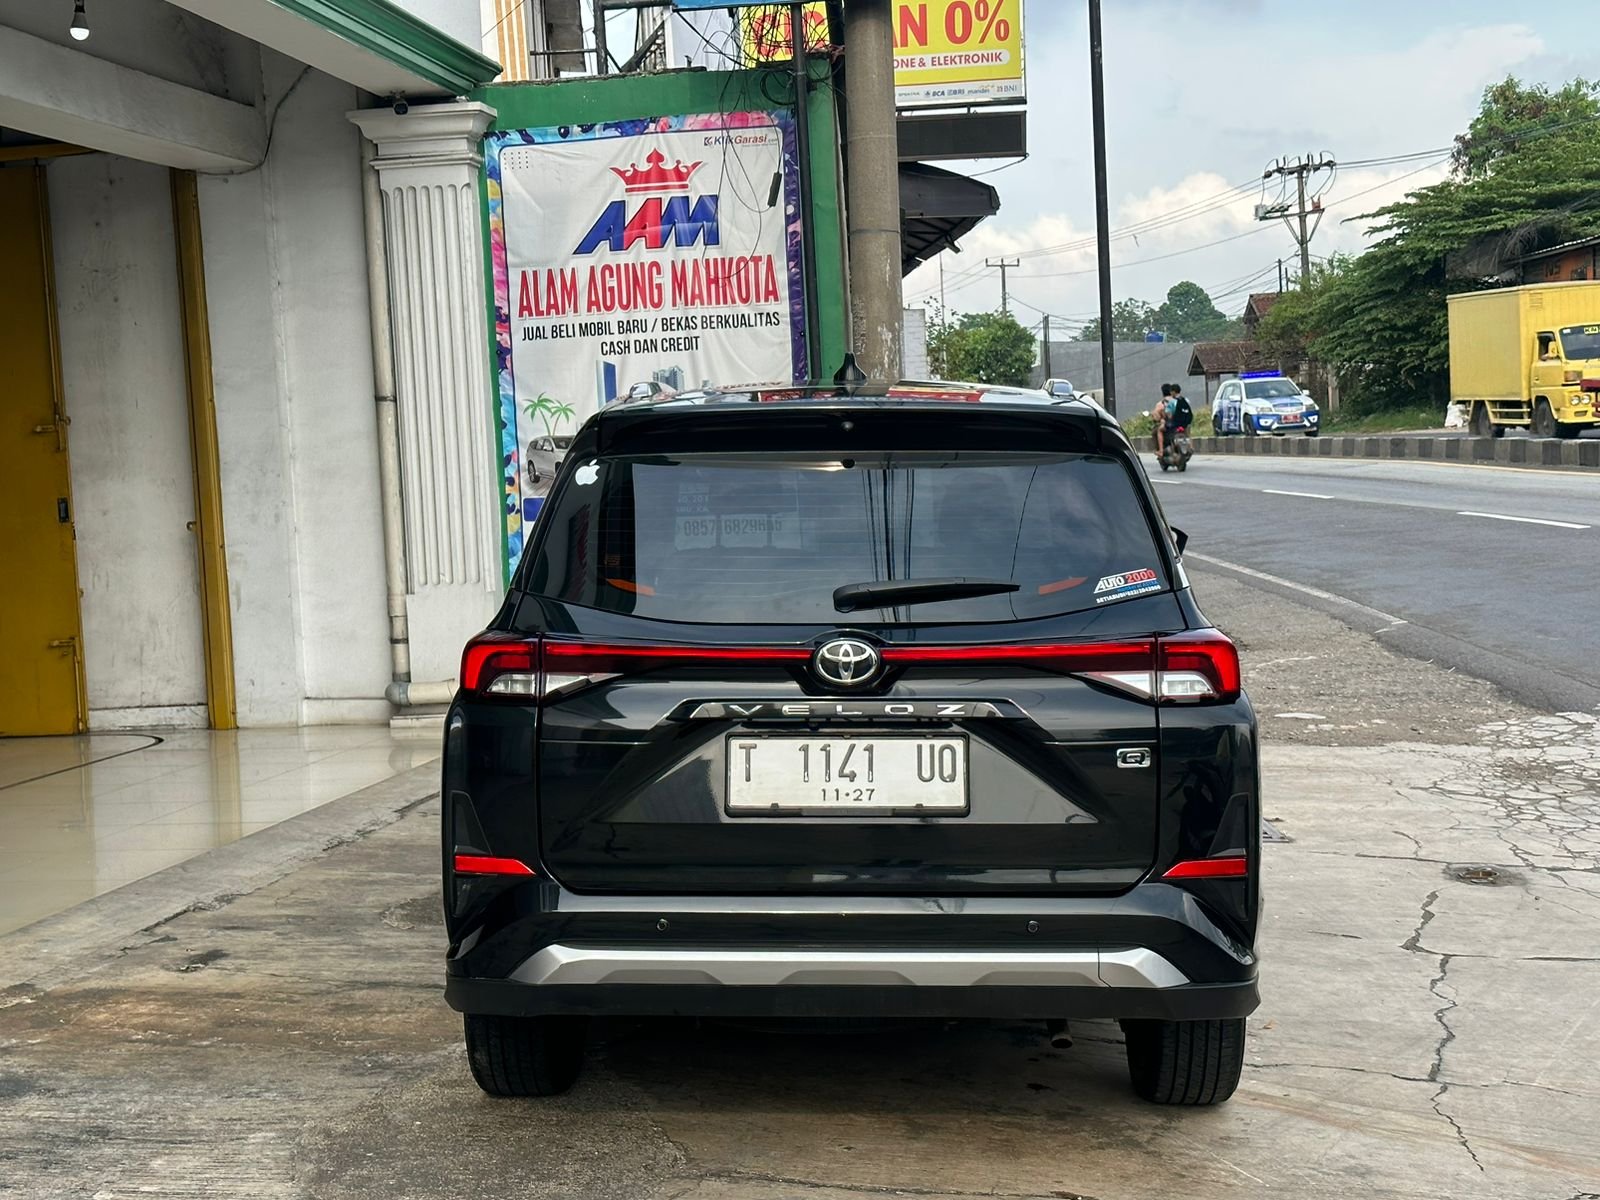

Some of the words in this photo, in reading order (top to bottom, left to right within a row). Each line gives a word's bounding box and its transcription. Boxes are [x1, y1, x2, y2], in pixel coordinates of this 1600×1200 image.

[944, 0, 1010, 45] 0%
[918, 56, 926, 68] &
[931, 51, 1003, 67] ELEKTRONIK
[572, 194, 720, 255] AAM
[518, 267, 579, 318] ALAM
[586, 260, 663, 313] AGUNG
[671, 254, 780, 308] MAHKOTA
[521, 325, 548, 341] JUAL
[551, 323, 576, 339] BELI
[578, 320, 615, 338] MOBIL
[617, 318, 648, 335] BARU
[650, 317, 657, 333] /
[661, 315, 698, 332] BEKAS
[701, 311, 780, 330] BERKUALITAS
[600, 339, 631, 356] CASH
[633, 337, 658, 354] DAN
[660, 335, 700, 352] CREDIT
[729, 704, 966, 716] VELOZ
[739, 743, 757, 782] T
[798, 743, 875, 782] 1141
